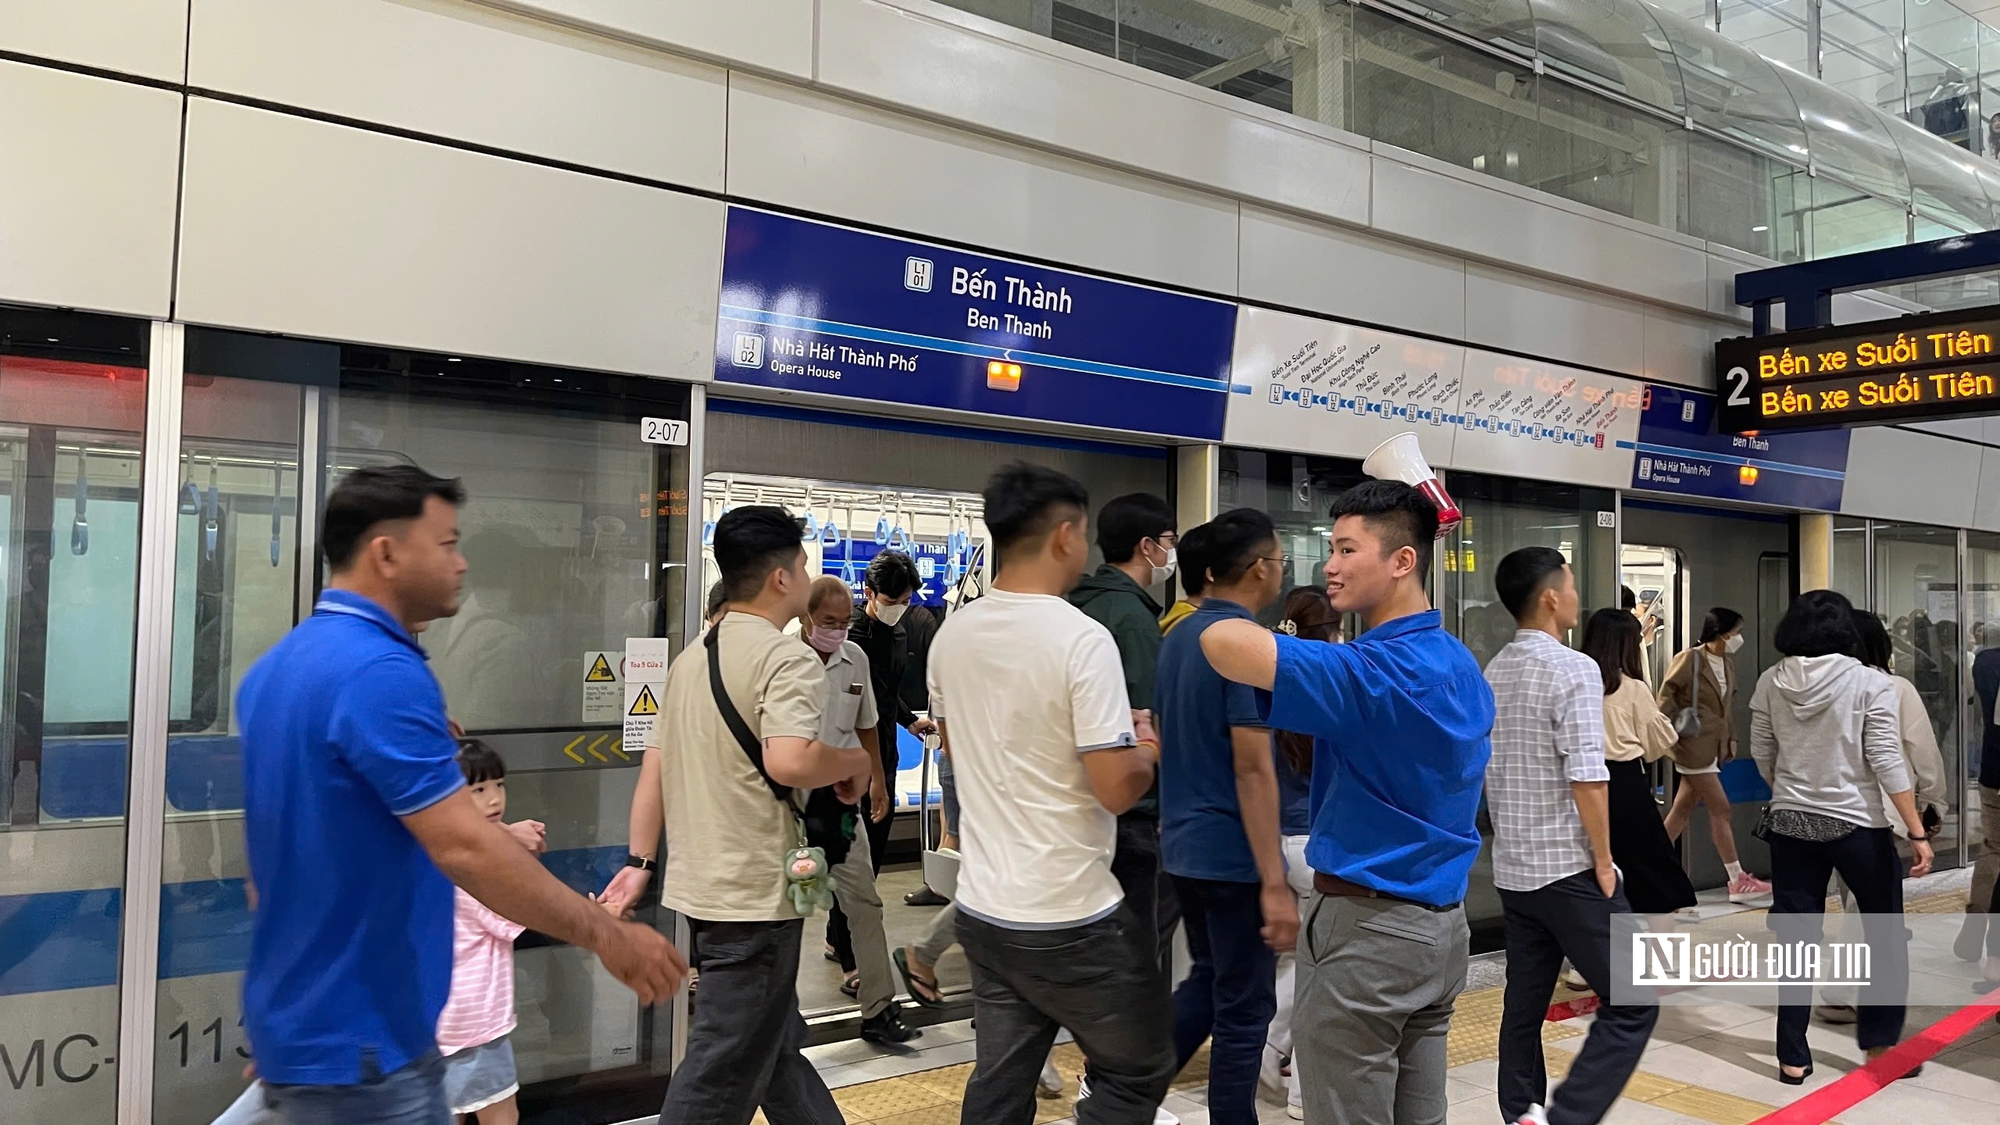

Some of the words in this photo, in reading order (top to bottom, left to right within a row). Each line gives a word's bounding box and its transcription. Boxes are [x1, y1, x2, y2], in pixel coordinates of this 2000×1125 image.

[914, 262, 925, 275] L1
[913, 274, 924, 287] 01
[951, 266, 997, 301] Bến
[1004, 276, 1072, 314] Thành
[967, 307, 999, 331] Ben
[1004, 313, 1052, 339] Thanh
[743, 338, 756, 350] L1
[741, 352, 754, 364] 02
[772, 337, 804, 357] Nhà
[809, 341, 835, 361] Hát
[839, 345, 884, 368] Thành
[888, 353, 919, 372] Phố
[1271, 367, 1284, 379] Bến
[1283, 361, 1292, 370] Xe
[1305, 340, 1318, 353] Tiên
[1759, 347, 1810, 379] Bến
[1817, 350, 1848, 372] xe
[1856, 333, 1917, 368] Suối
[1926, 330, 1991, 359] Tiên
[770, 360, 804, 375] Opera
[807, 365, 842, 380] House
[1328, 376, 1341, 387] Khu
[1340, 364, 1356, 378] Công
[1370, 343, 1381, 355] Cao
[1726, 366, 1750, 407] 2
[1761, 385, 1812, 416] Bến
[1819, 388, 1850, 411] xe
[1858, 372, 1919, 406] Suối
[1928, 371, 1993, 398] Tiên
[648, 421, 680, 441] 2-07
[1732, 436, 1747, 448] Ben
[1748, 437, 1769, 451] Thanh
[1654, 459, 1667, 472] Nhà
[1668, 461, 1679, 472] Hát
[1679, 462, 1698, 475] Thành
[1699, 465, 1712, 477] Phố
[1599, 513, 1612, 526] 2-08
